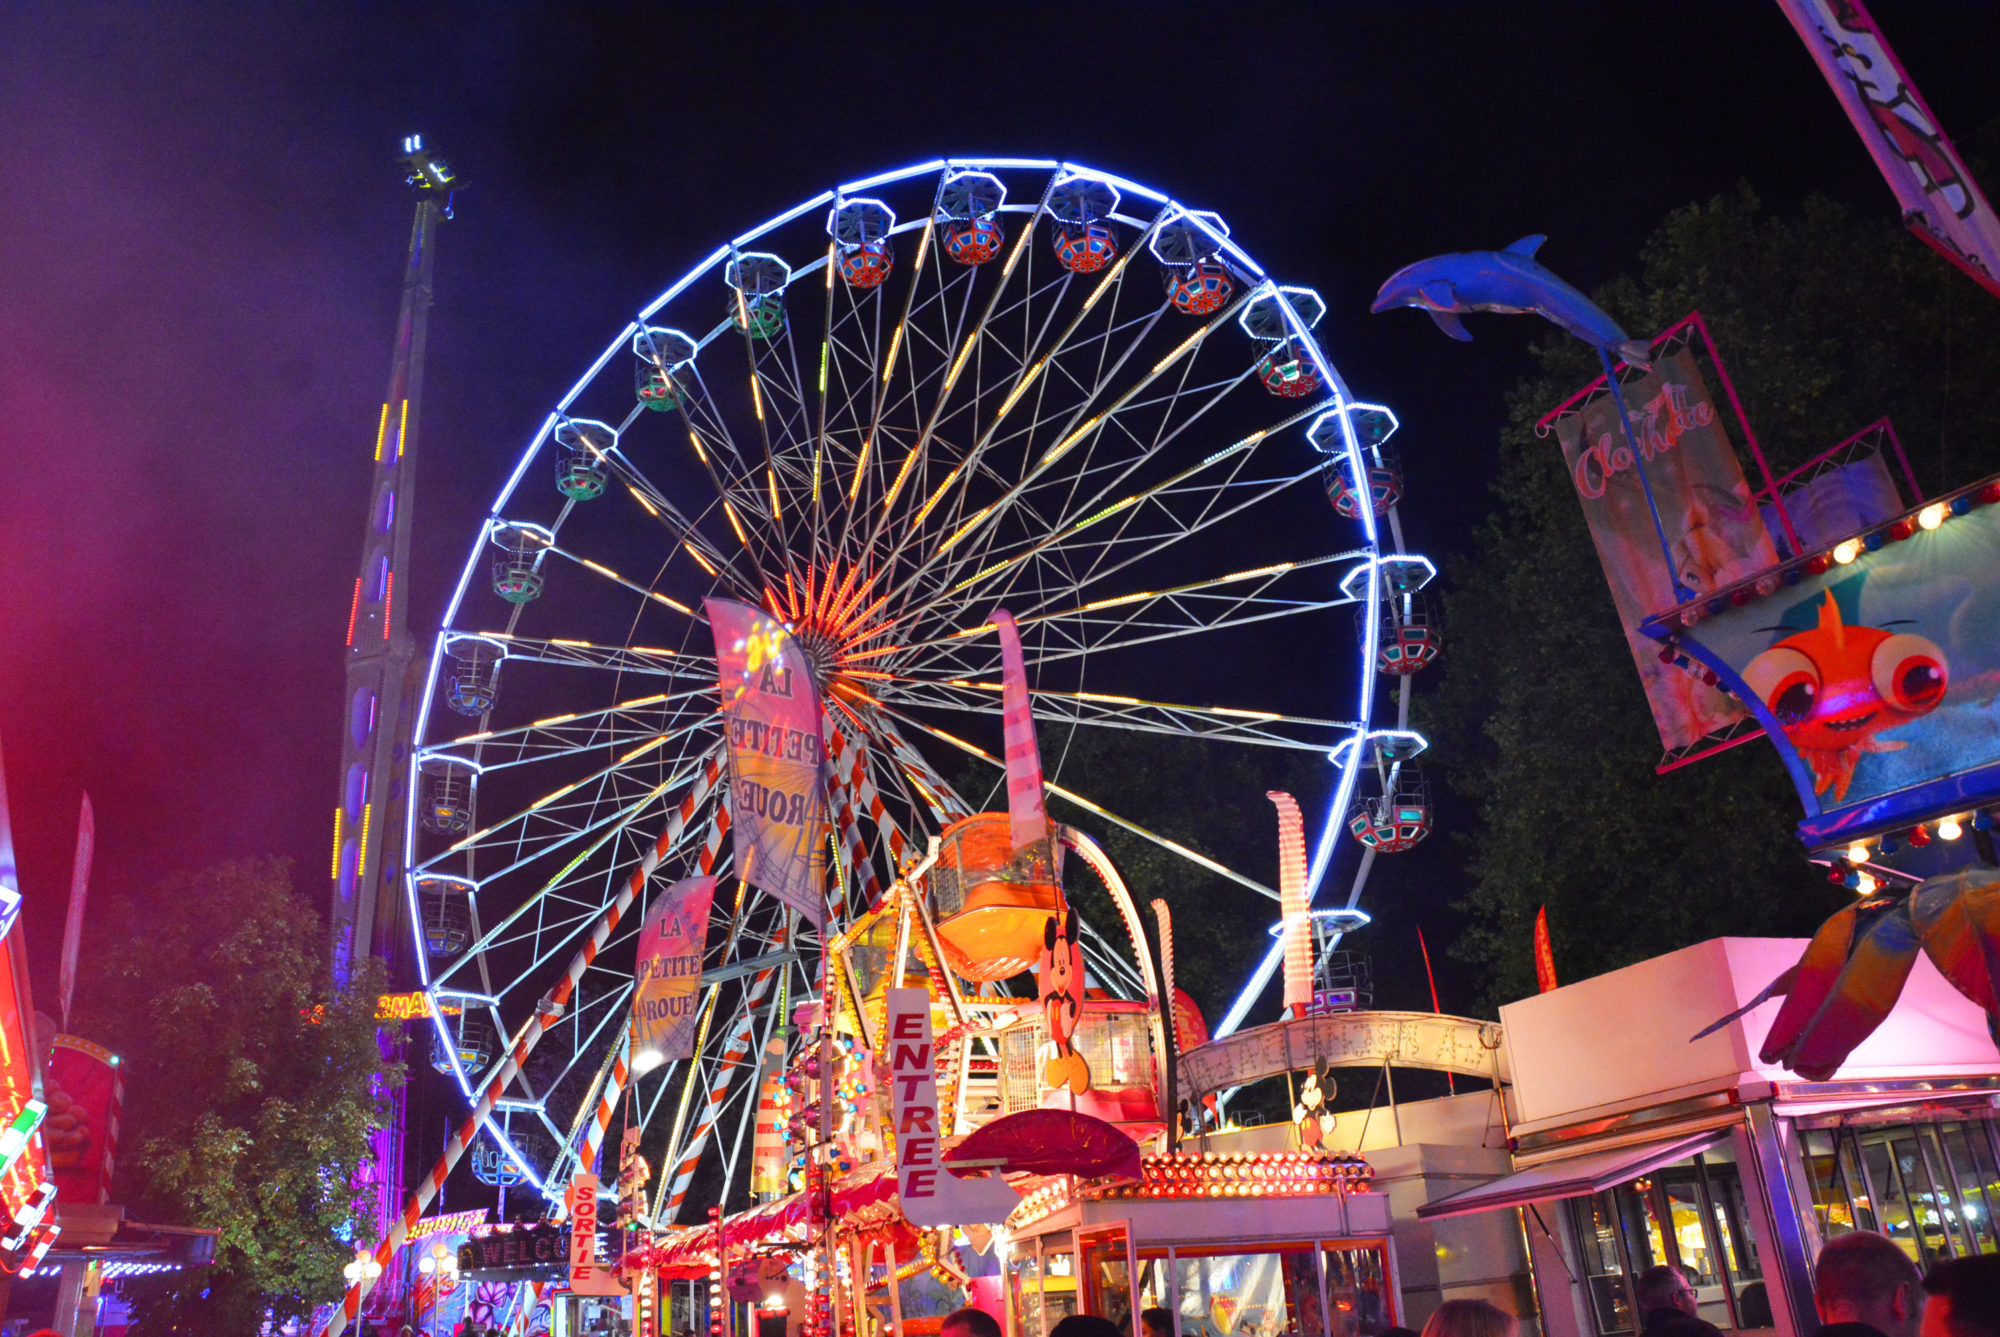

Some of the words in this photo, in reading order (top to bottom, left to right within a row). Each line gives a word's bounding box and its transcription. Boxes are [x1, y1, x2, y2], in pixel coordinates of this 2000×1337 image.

[659, 916, 683, 938] LA
[638, 955, 701, 981] PETITE
[645, 994, 694, 1021] ROUE
[892, 1013, 937, 1198] ENTREE
[481, 1231, 609, 1266] WELCOE
[573, 1187, 595, 1279] SORTIE
